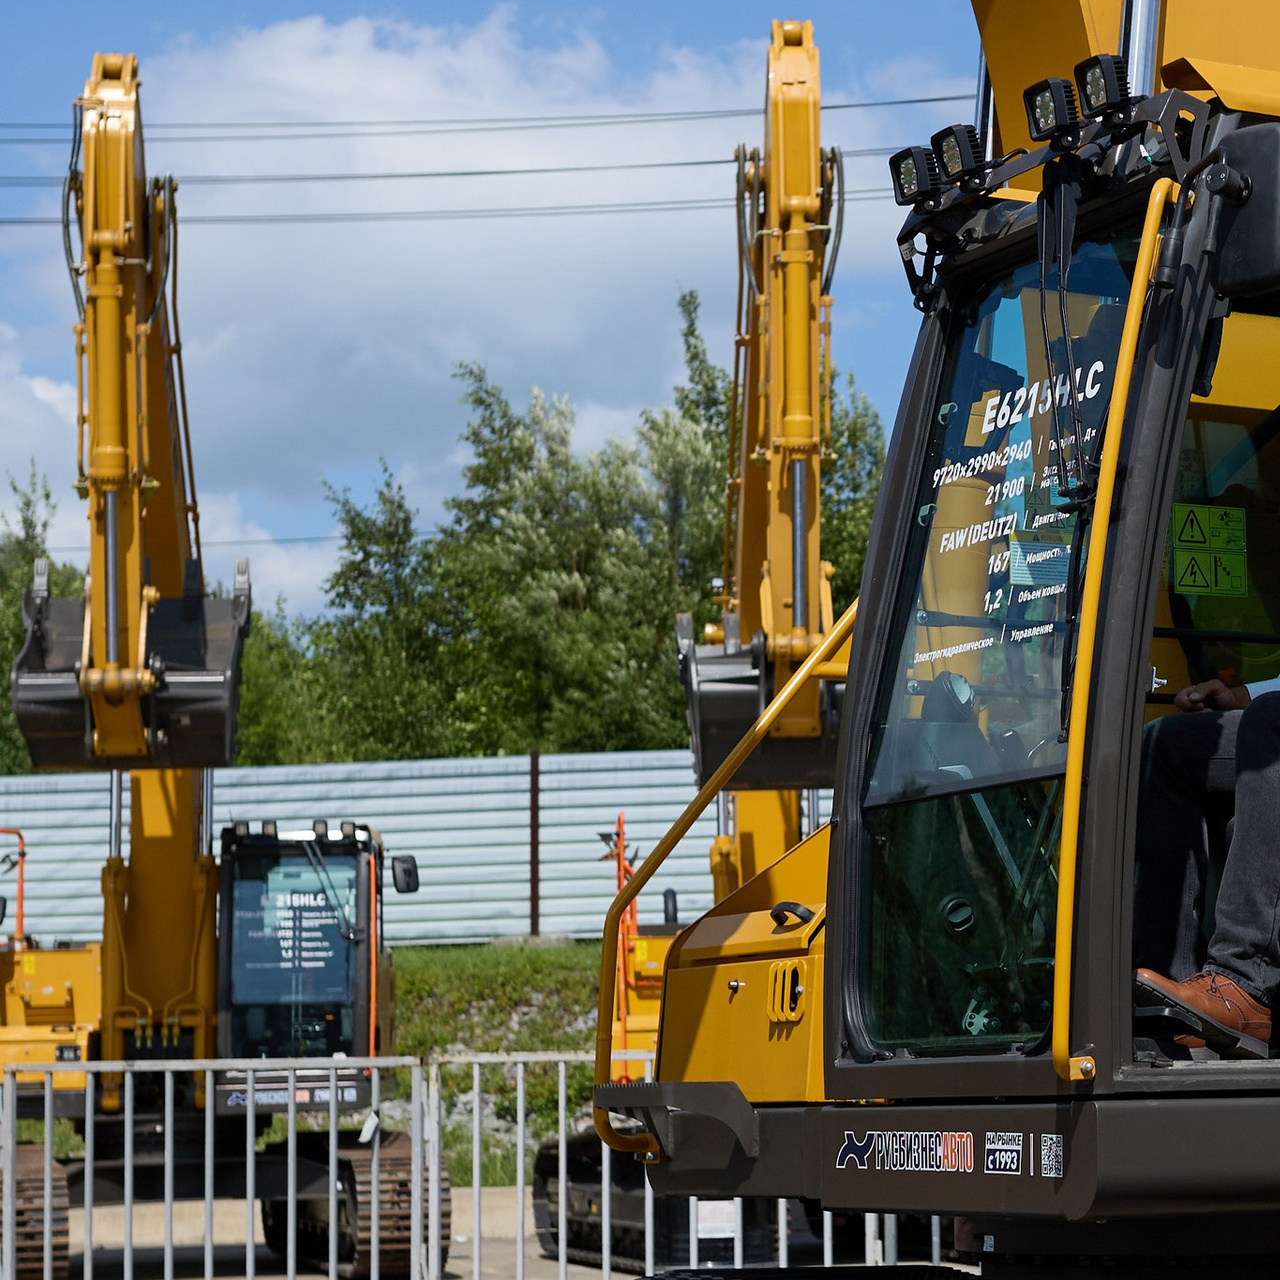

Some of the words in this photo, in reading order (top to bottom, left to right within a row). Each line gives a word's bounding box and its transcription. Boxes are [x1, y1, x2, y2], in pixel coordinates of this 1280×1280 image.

[987, 550, 1011, 575] 167
[984, 588, 1003, 614] 1,2
[1010, 624, 1054, 642] Управление
[986, 1132, 997, 1146] НА
[997, 1133, 1022, 1147] РЫНКЕ
[875, 1131, 974, 1173] РУСБИЗНЕСАВТО
[994, 1150, 1018, 1170] 1993
